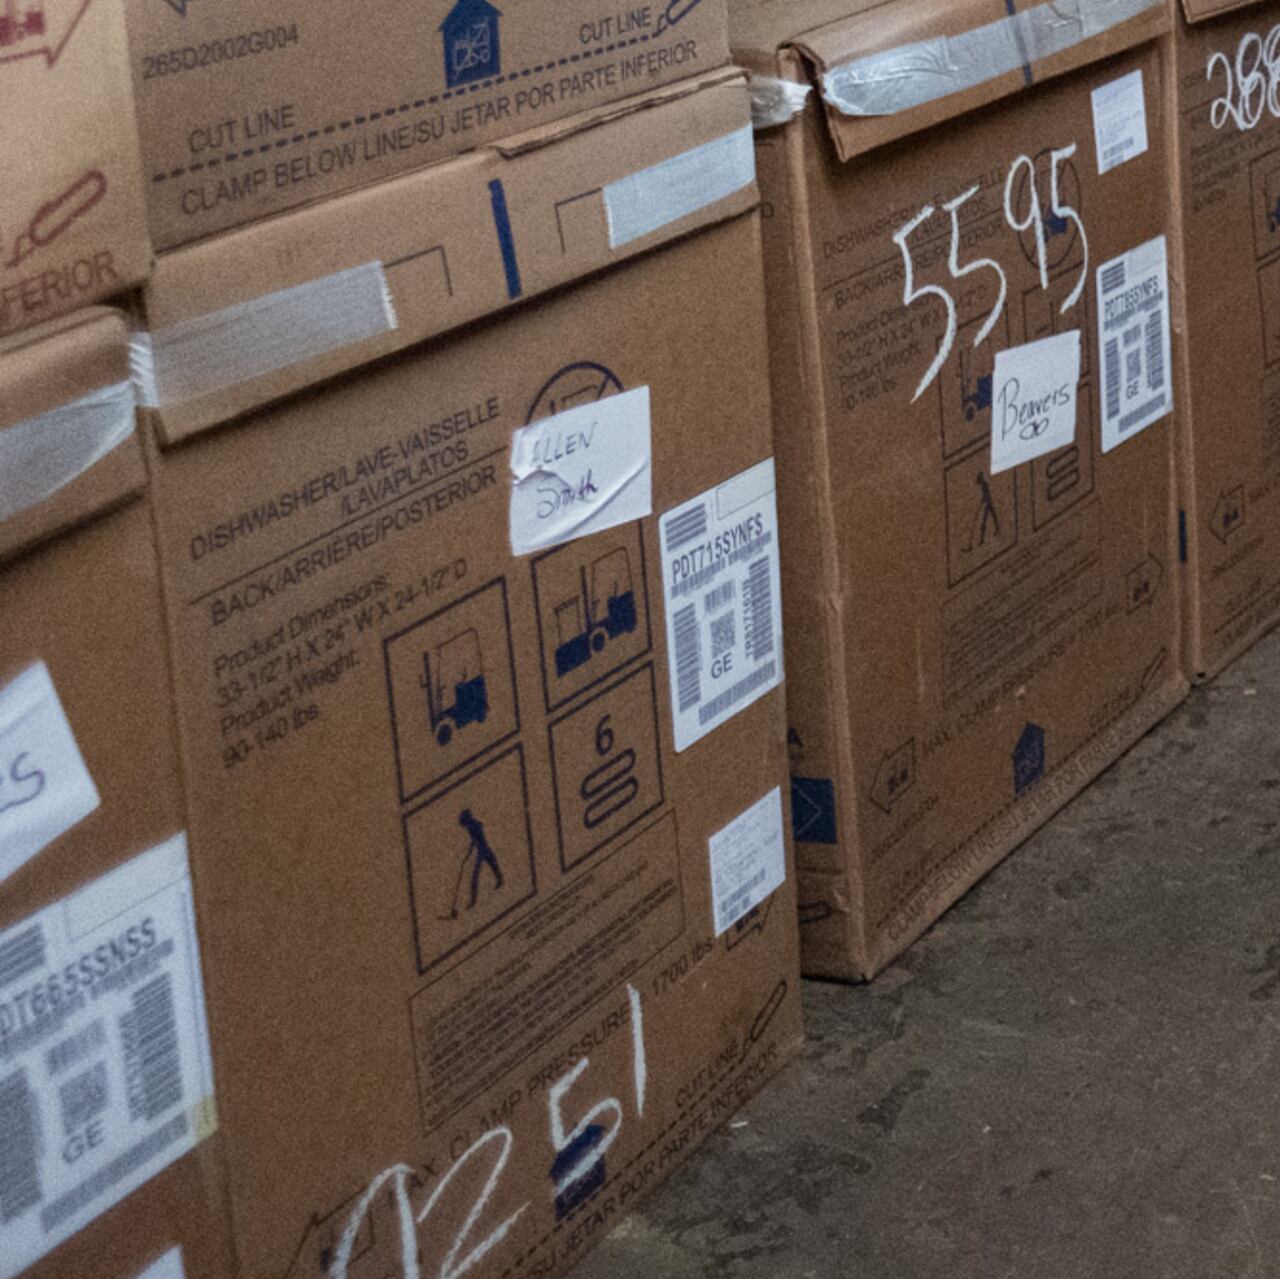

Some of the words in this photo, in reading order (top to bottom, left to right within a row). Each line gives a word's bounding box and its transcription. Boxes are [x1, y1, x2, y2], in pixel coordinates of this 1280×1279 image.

[578, 14, 614, 45] CUT
[616, 6, 654, 37] LINE
[180, 168, 267, 217] CLAMP
[273, 143, 359, 190] BELOW
[362, 114, 446, 162] LINE/SU
[449, 96, 512, 139] JETAR
[514, 81, 556, 117] POR
[558, 62, 617, 105] PARTE
[619, 39, 700, 84] INFERIOR
[188, 114, 239, 155] CUT
[244, 104, 298, 142] LINE
[892, 141, 1088, 405] 5595
[189, 396, 502, 563] DISHWASHER/LAVE-VAISSELLE
[338, 438, 471, 519] /LAVAPLATOS
[710, 652, 736, 683] GE
[596, 714, 615, 754] 6
[61, 1120, 107, 1166] GE
